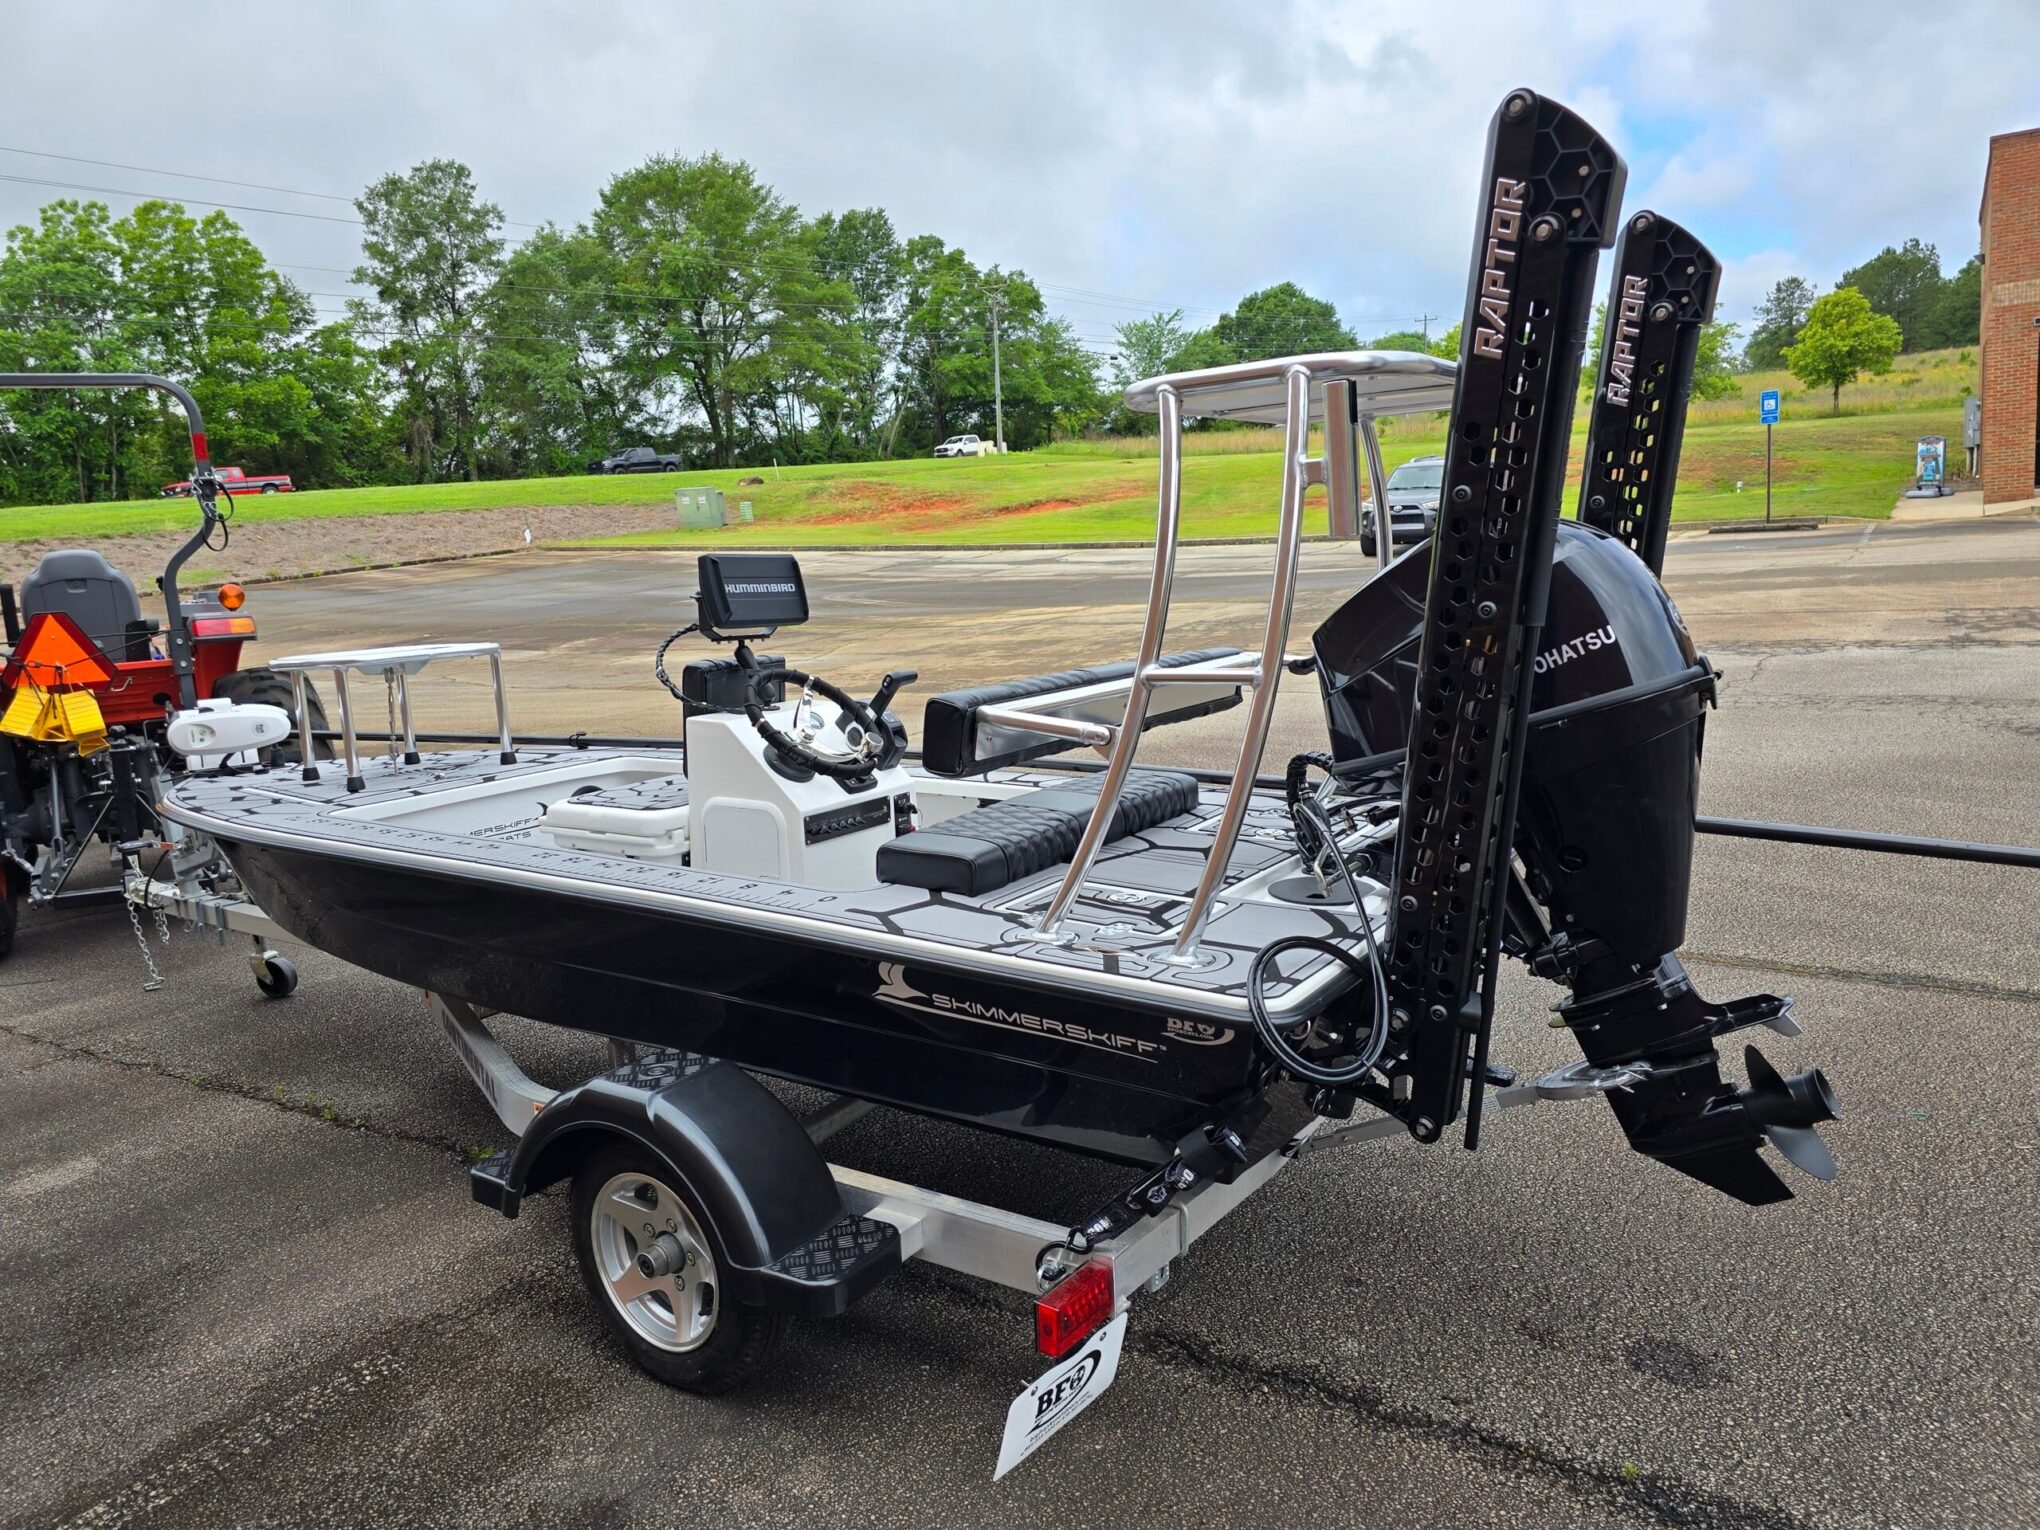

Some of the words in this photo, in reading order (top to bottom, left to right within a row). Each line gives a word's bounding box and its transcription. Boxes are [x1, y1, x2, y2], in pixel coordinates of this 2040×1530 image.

[1474, 176, 1526, 360] RAPTOR
[1606, 275, 1649, 407] RAPTOR
[724, 583, 796, 593] HUMMINBIRD
[1534, 625, 1616, 674] OHATSU
[932, 993, 1158, 1054] SKIMMERSKIFF
